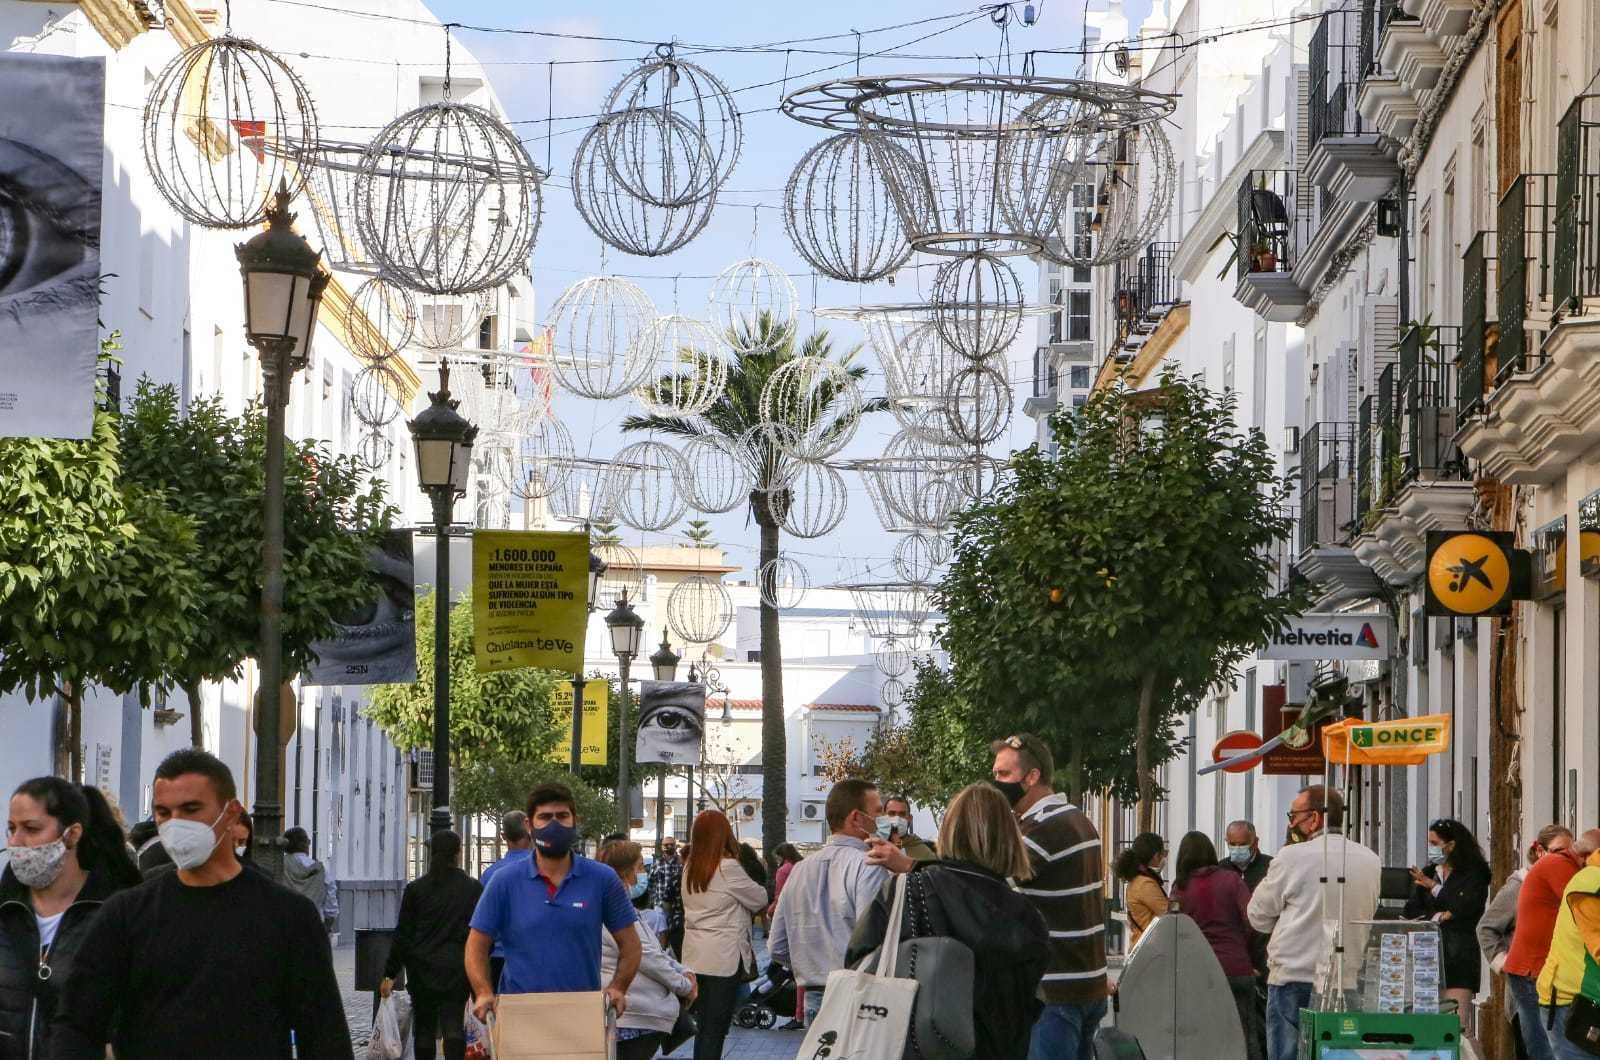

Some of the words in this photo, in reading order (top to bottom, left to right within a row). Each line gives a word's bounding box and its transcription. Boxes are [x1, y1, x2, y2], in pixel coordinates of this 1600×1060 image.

[495, 549, 556, 562] 1.600.000
[488, 563, 523, 572] MENORES
[524, 563, 534, 572] EN
[535, 562, 564, 572] ESPAÑA
[488, 580, 503, 590] QUE
[504, 580, 514, 589] LA
[515, 580, 540, 590] MUJER
[488, 590, 530, 600] SUFRIENDO
[556, 591, 574, 601] TIPO
[488, 600, 498, 610] DE
[499, 600, 538, 609] VIOLENCIA
[1272, 627, 1353, 646] helvetia
[486, 640, 534, 653] Chiclana
[1377, 727, 1437, 744] ONCE
